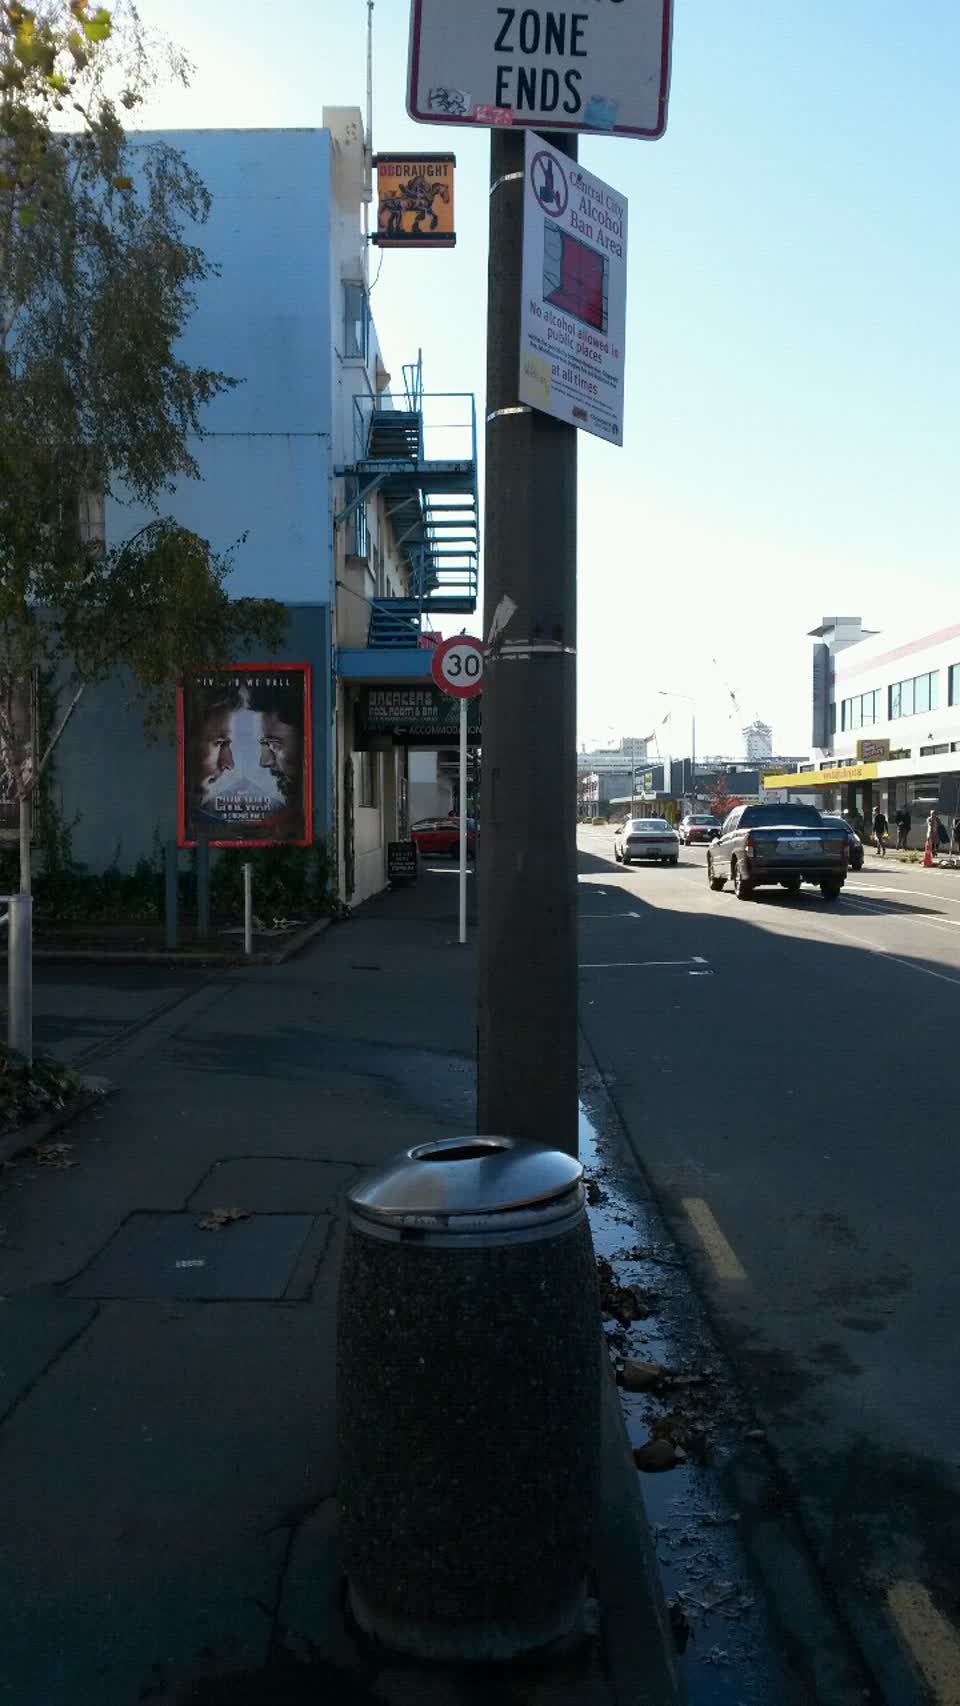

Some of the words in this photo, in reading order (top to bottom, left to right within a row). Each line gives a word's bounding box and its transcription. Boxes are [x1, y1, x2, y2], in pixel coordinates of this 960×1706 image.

[494, 7, 588, 57] ZONE
[495, 65, 582, 114] ENDS
[569, 171, 604, 207] Central
[606, 196, 624, 221] City
[570, 208, 593, 239] Ban
[596, 228, 623, 258] Area
[579, 196, 624, 239] Alcohol
[529, 300, 542, 318] No
[543, 310, 576, 336] alcohol
[547, 327, 574, 350] public
[576, 341, 603, 364] places
[574, 373, 599, 396] times
[447, 654, 480, 677] 30
[408, 725, 482, 736] ACCOMMODION
